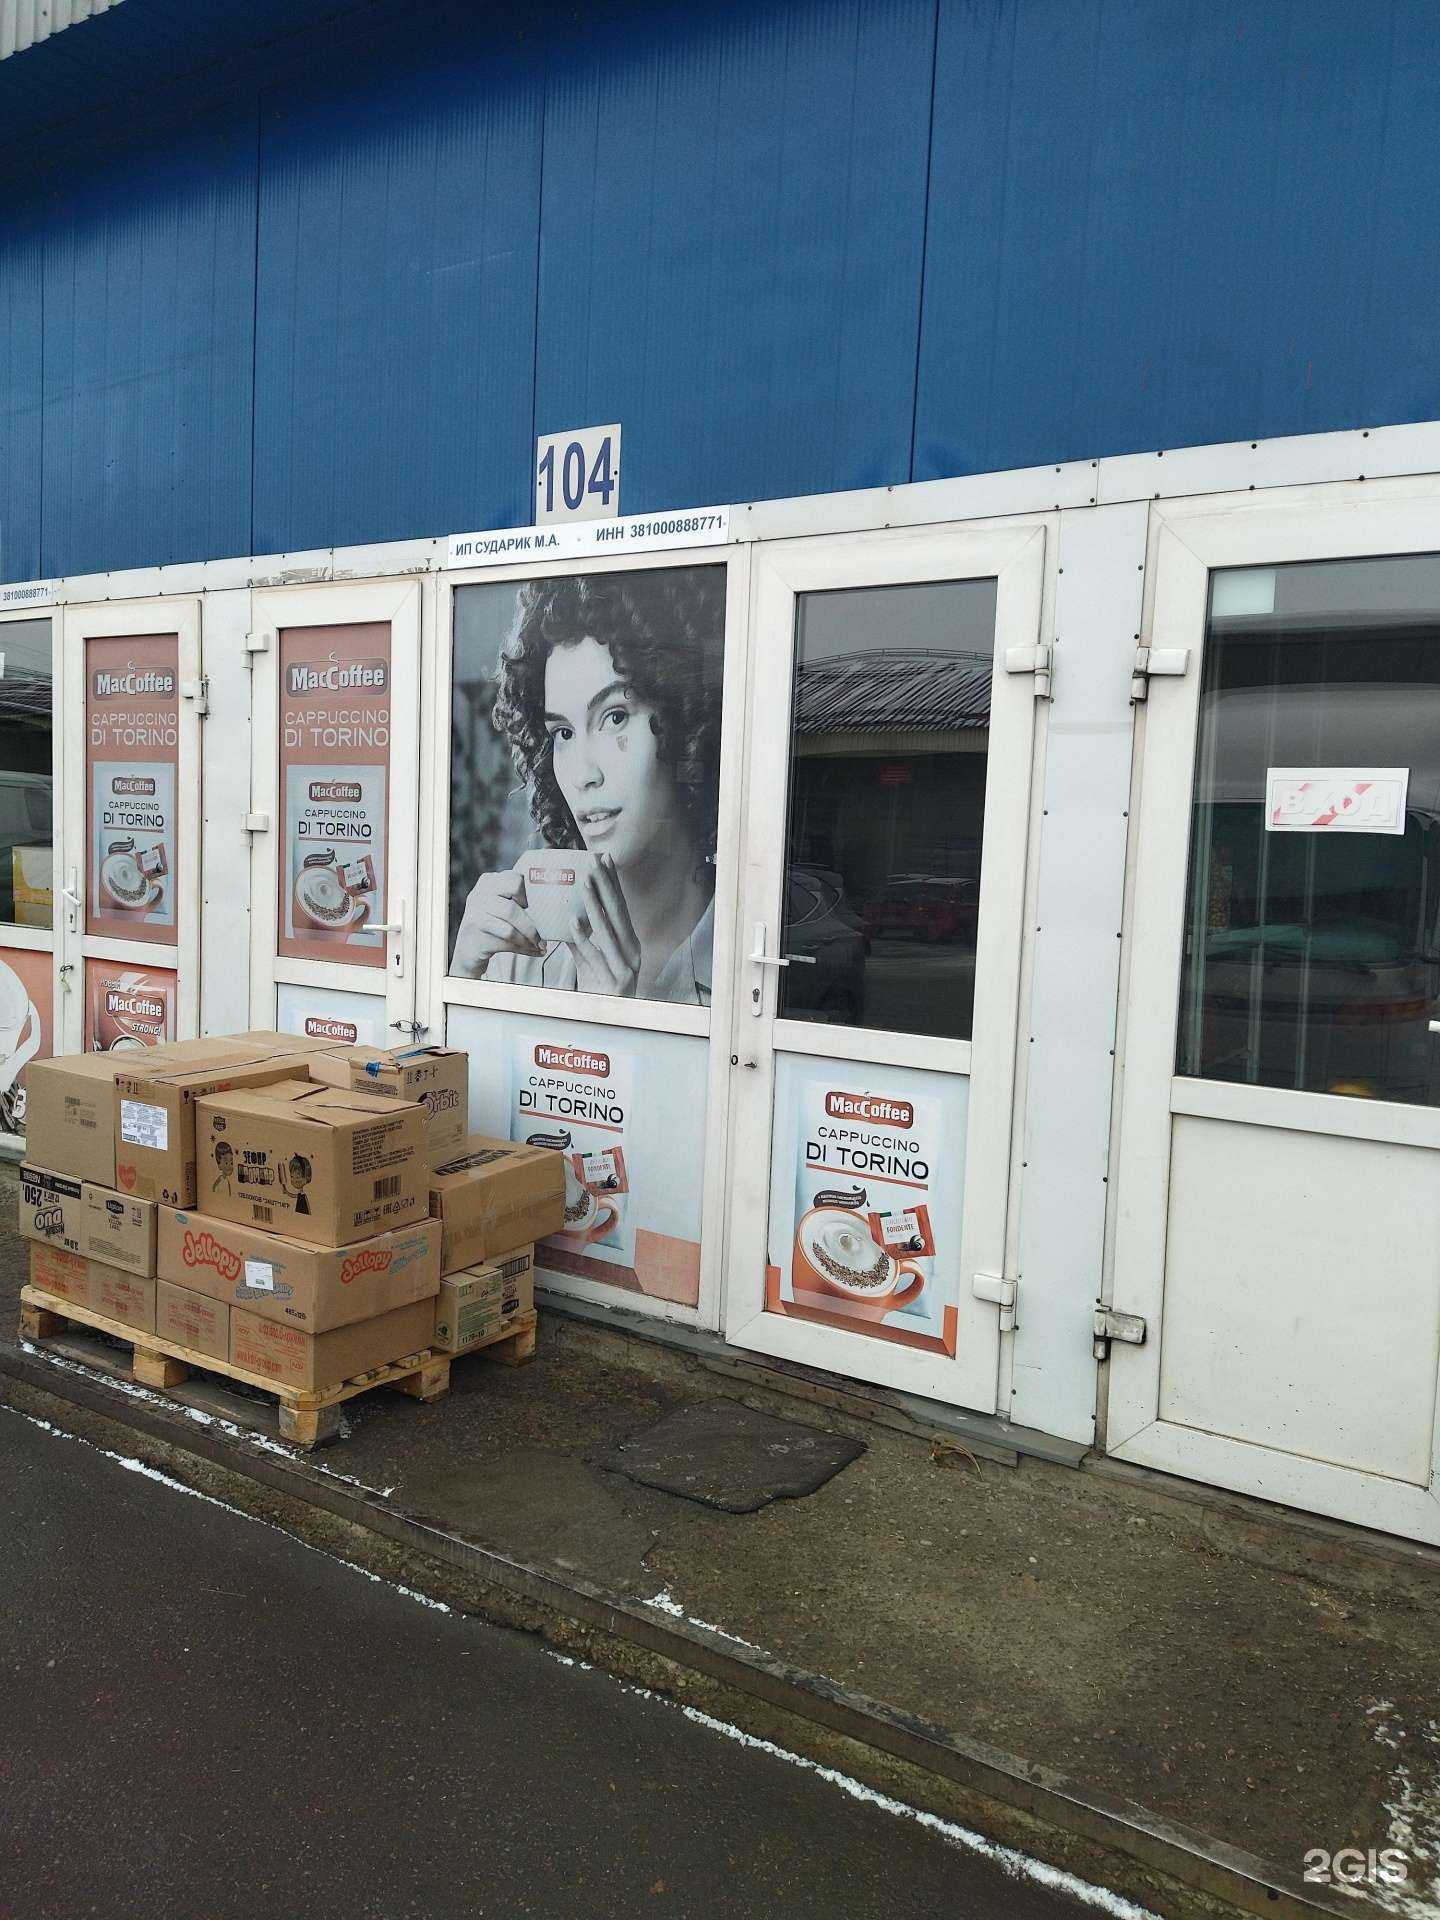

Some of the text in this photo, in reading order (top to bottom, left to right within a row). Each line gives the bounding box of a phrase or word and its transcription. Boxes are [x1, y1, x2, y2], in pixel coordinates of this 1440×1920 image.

[538, 437, 615, 512] 104
[596, 515, 723, 542] ИНН 381000888771
[456, 534, 560, 556] ИП СУДАРИК М.А.
[97, 673, 173, 695] MacCoffee
[291, 665, 384, 691] MacCoffee
[92, 712, 177, 727] CAPPUCCINO
[285, 710, 388, 725] CAPPUCCINO
[92, 728, 177, 746] DI TORINO
[285, 727, 389, 747] DI TORINO
[114, 779, 154, 792] MacCoffee
[311, 785, 360, 799] MacCoffee
[109, 801, 160, 811] CAPPUCCINO
[304, 809, 366, 819] CAPPUCCINO
[103, 812, 164, 827] DI TORINO
[298, 821, 372, 837] DI TORINO
[108, 995, 162, 1017] MacCoffee
[308, 1020, 355, 1038] MacCoffee
[538, 1048, 607, 1072] MacCoffee
[529, 1076, 616, 1099] CAPPUCCINO
[519, 1090, 623, 1123] DI TORINO
[830, 1096, 910, 1122] MacCoffee
[818, 1126, 920, 1153] CAPPUCCINO
[806, 1142, 929, 1180] DI TORINO
[182, 1230, 241, 1281] Jellopy
[341, 1250, 392, 1285] Jellopy
